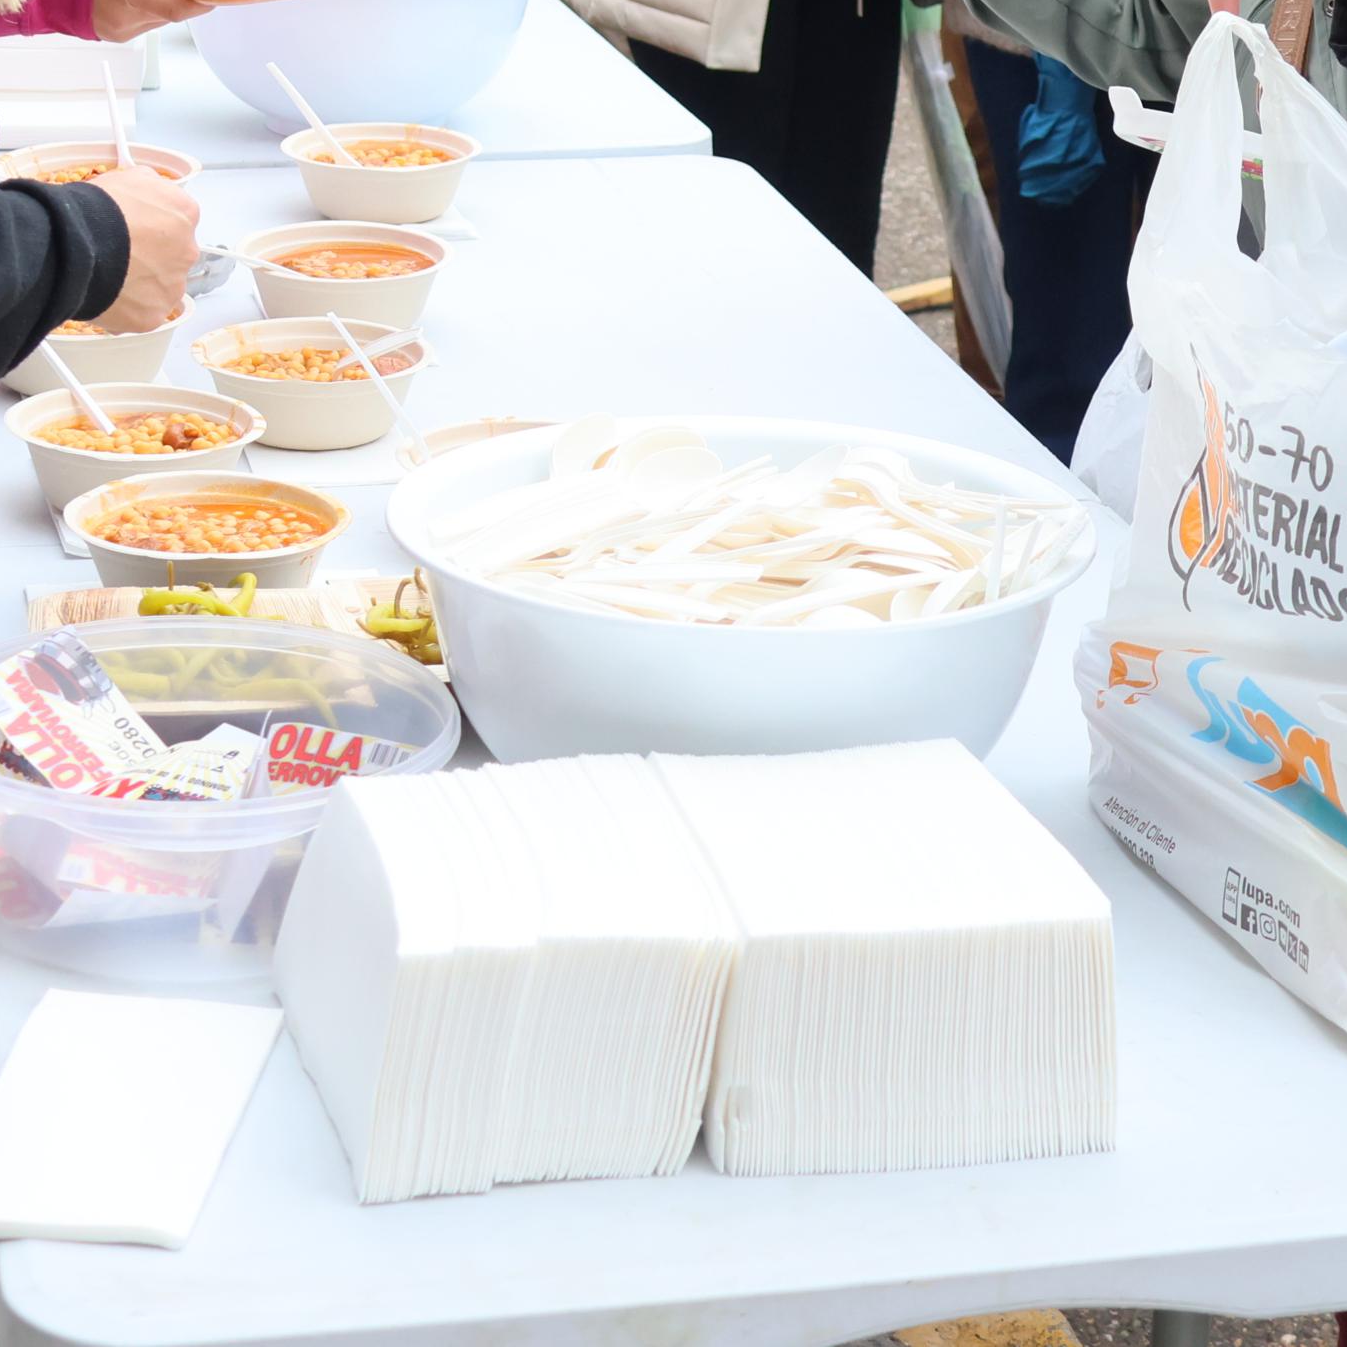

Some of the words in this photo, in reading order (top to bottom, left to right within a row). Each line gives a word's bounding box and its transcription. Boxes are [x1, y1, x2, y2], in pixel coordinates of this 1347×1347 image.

[5, 712, 84, 790] OLLA
[114, 716, 158, 760] 0280
[269, 724, 364, 771] OLLA
[1103, 796, 1140, 829] Atención
[1137, 819, 1147, 835] al
[1146, 824, 1177, 855] Cliente
[1241, 876, 1302, 930] lupa.com
